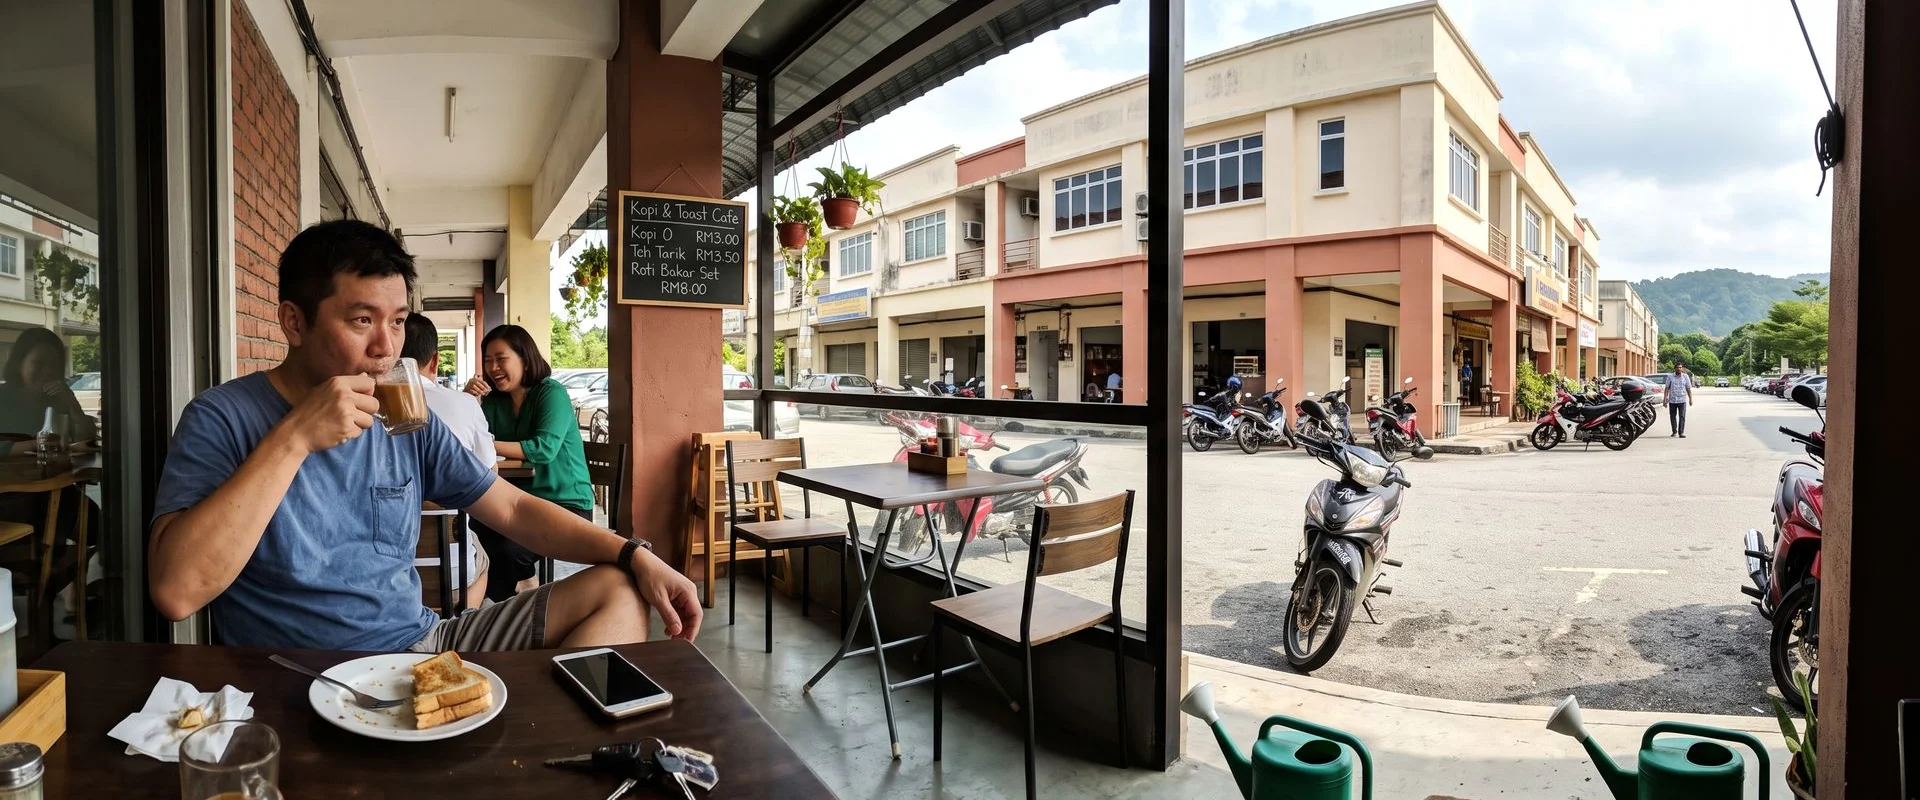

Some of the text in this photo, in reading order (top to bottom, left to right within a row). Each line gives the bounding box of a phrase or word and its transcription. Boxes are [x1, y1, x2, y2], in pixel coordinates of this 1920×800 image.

[630, 200, 739, 224] Kopi & Toast Cafe
[631, 225, 740, 246] Kopi O RM3.00
[630, 244, 740, 263] Teh Tarik RM3.50
[631, 262, 720, 280] Roti Bakar Set
[661, 281, 707, 296] RM8.00
